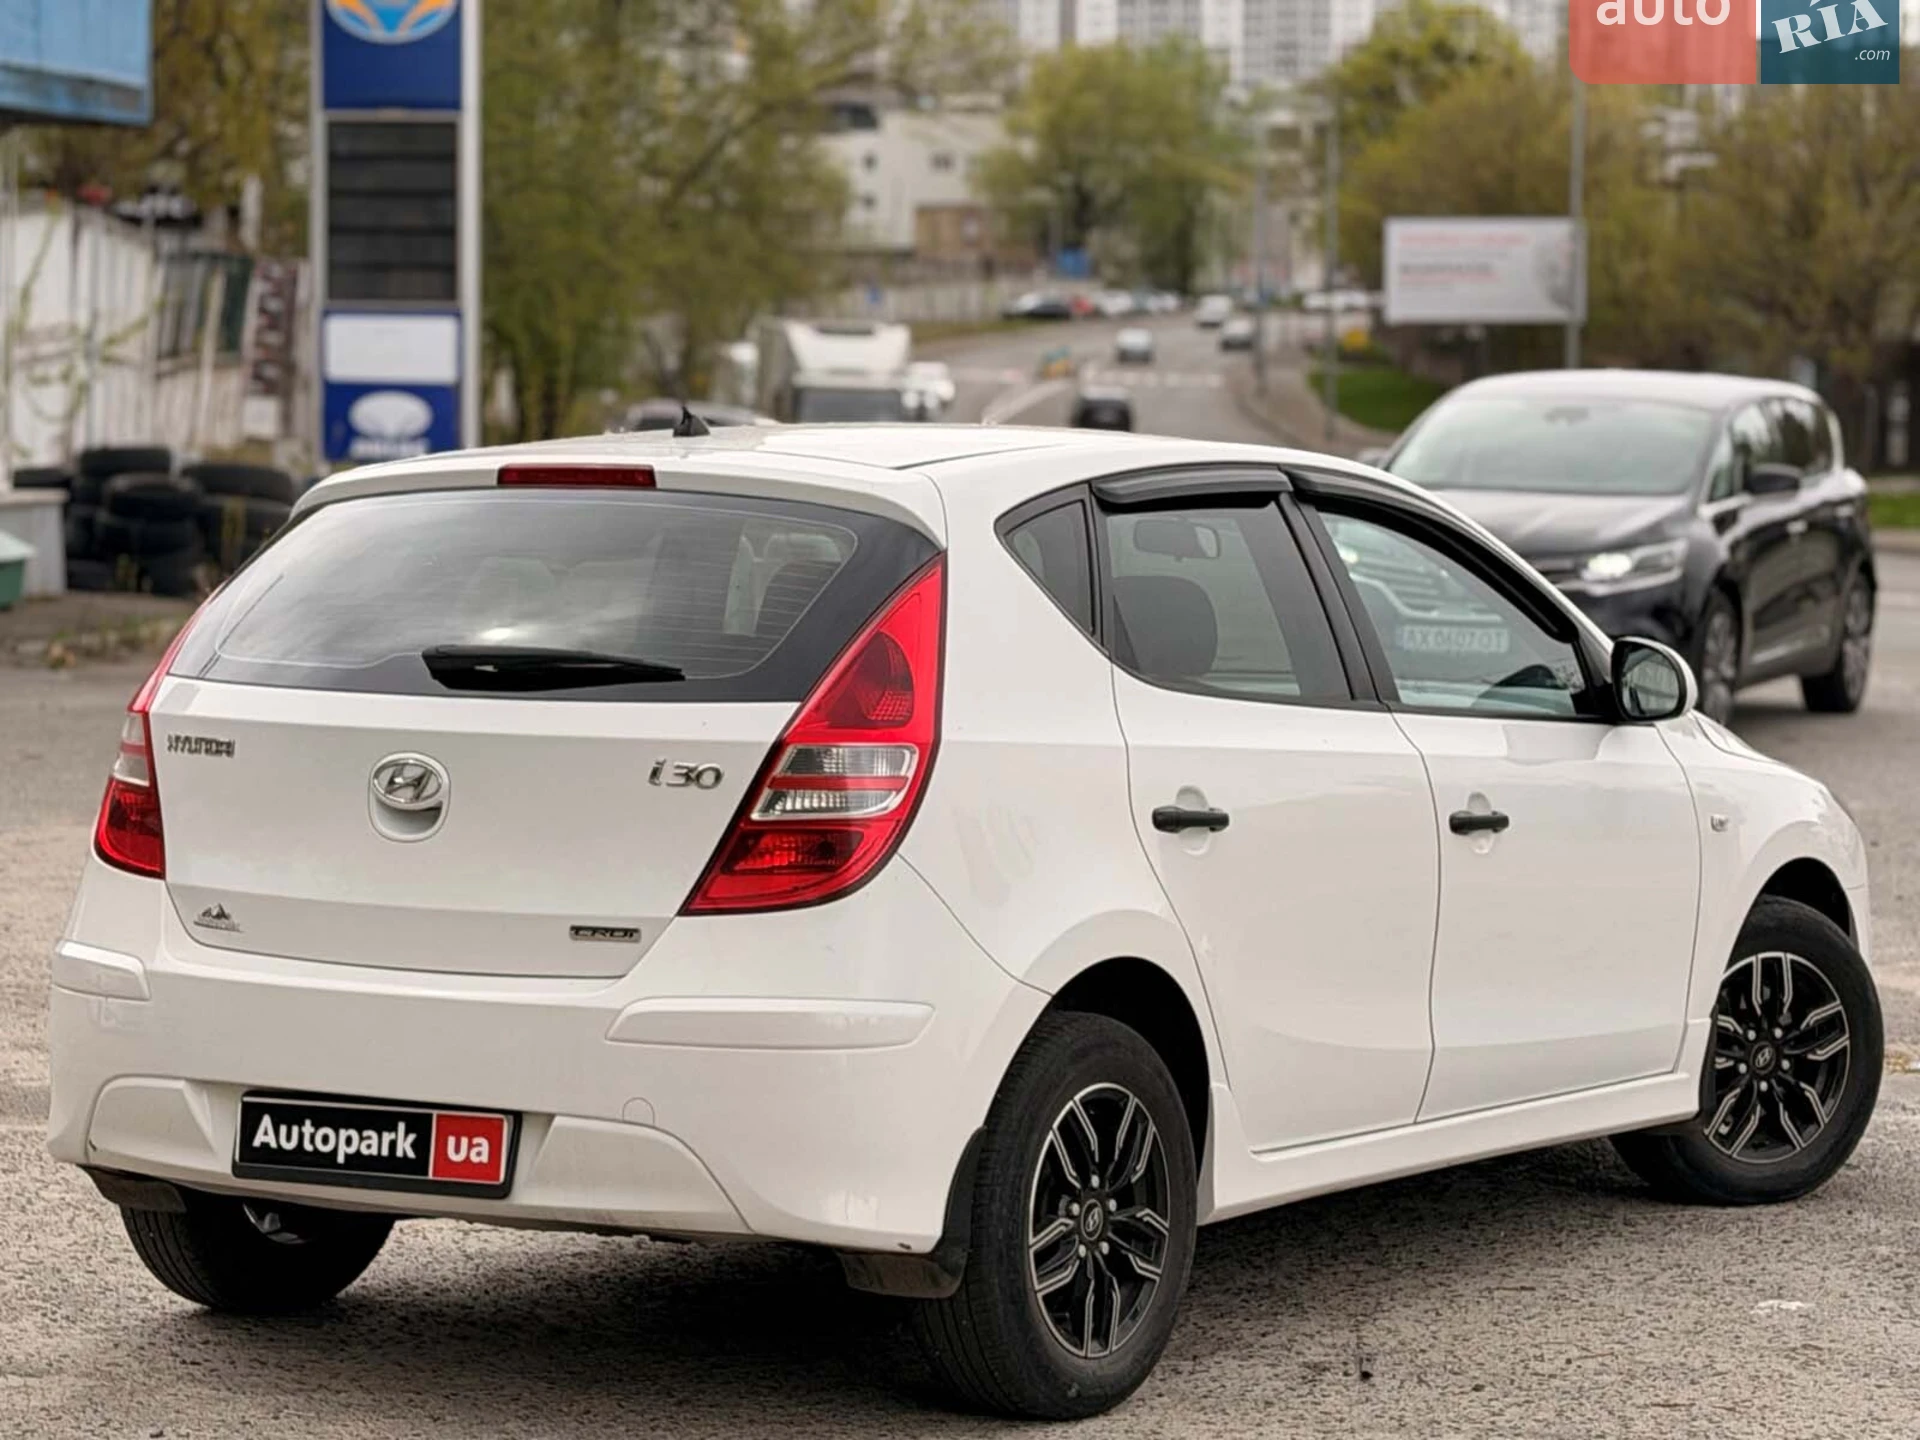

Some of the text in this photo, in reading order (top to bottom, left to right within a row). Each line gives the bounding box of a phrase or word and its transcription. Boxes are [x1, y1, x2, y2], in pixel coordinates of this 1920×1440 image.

[166, 734, 235, 759] HYUNDAI
[252, 1114, 489, 1163] Autopark ua
